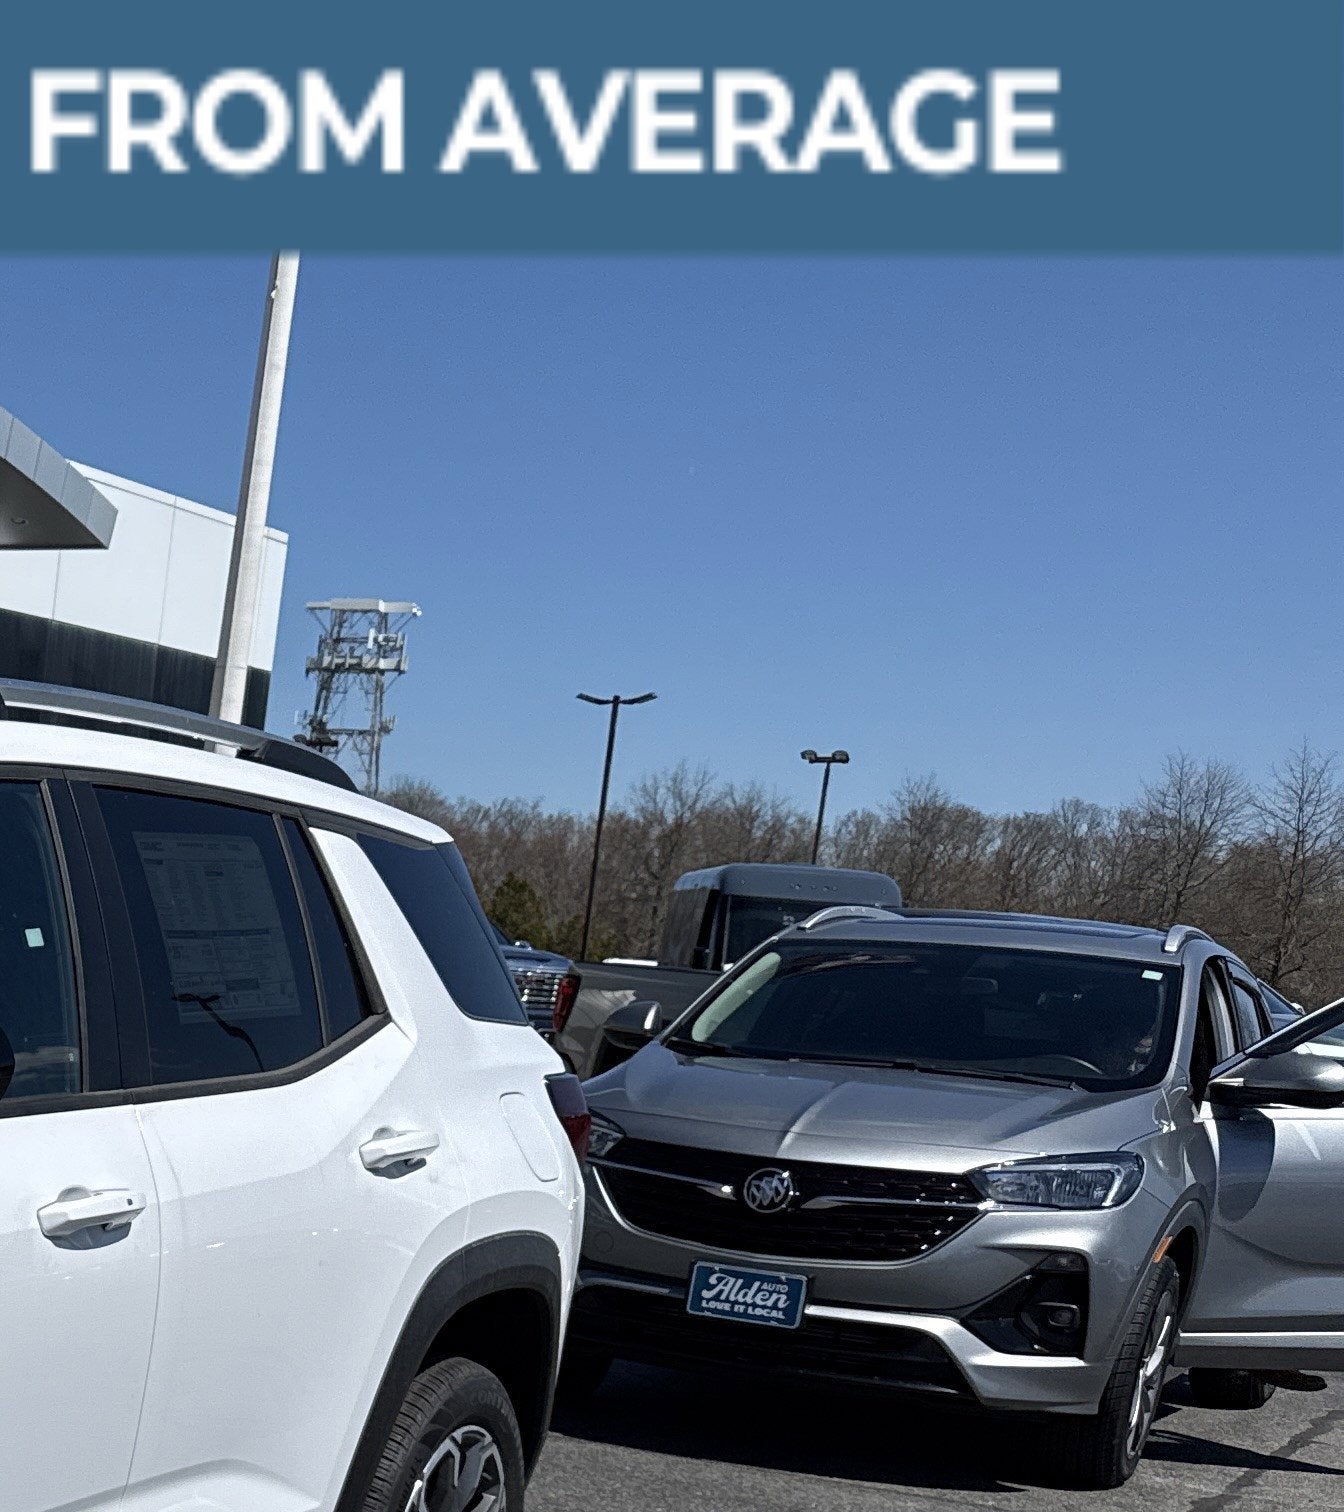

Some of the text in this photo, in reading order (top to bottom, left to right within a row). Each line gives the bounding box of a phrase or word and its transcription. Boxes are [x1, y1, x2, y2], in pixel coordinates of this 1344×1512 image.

[701, 1273, 791, 1309] Alden
[761, 1282, 789, 1293] AUTO
[747, 1305, 786, 1319] LOCAL
